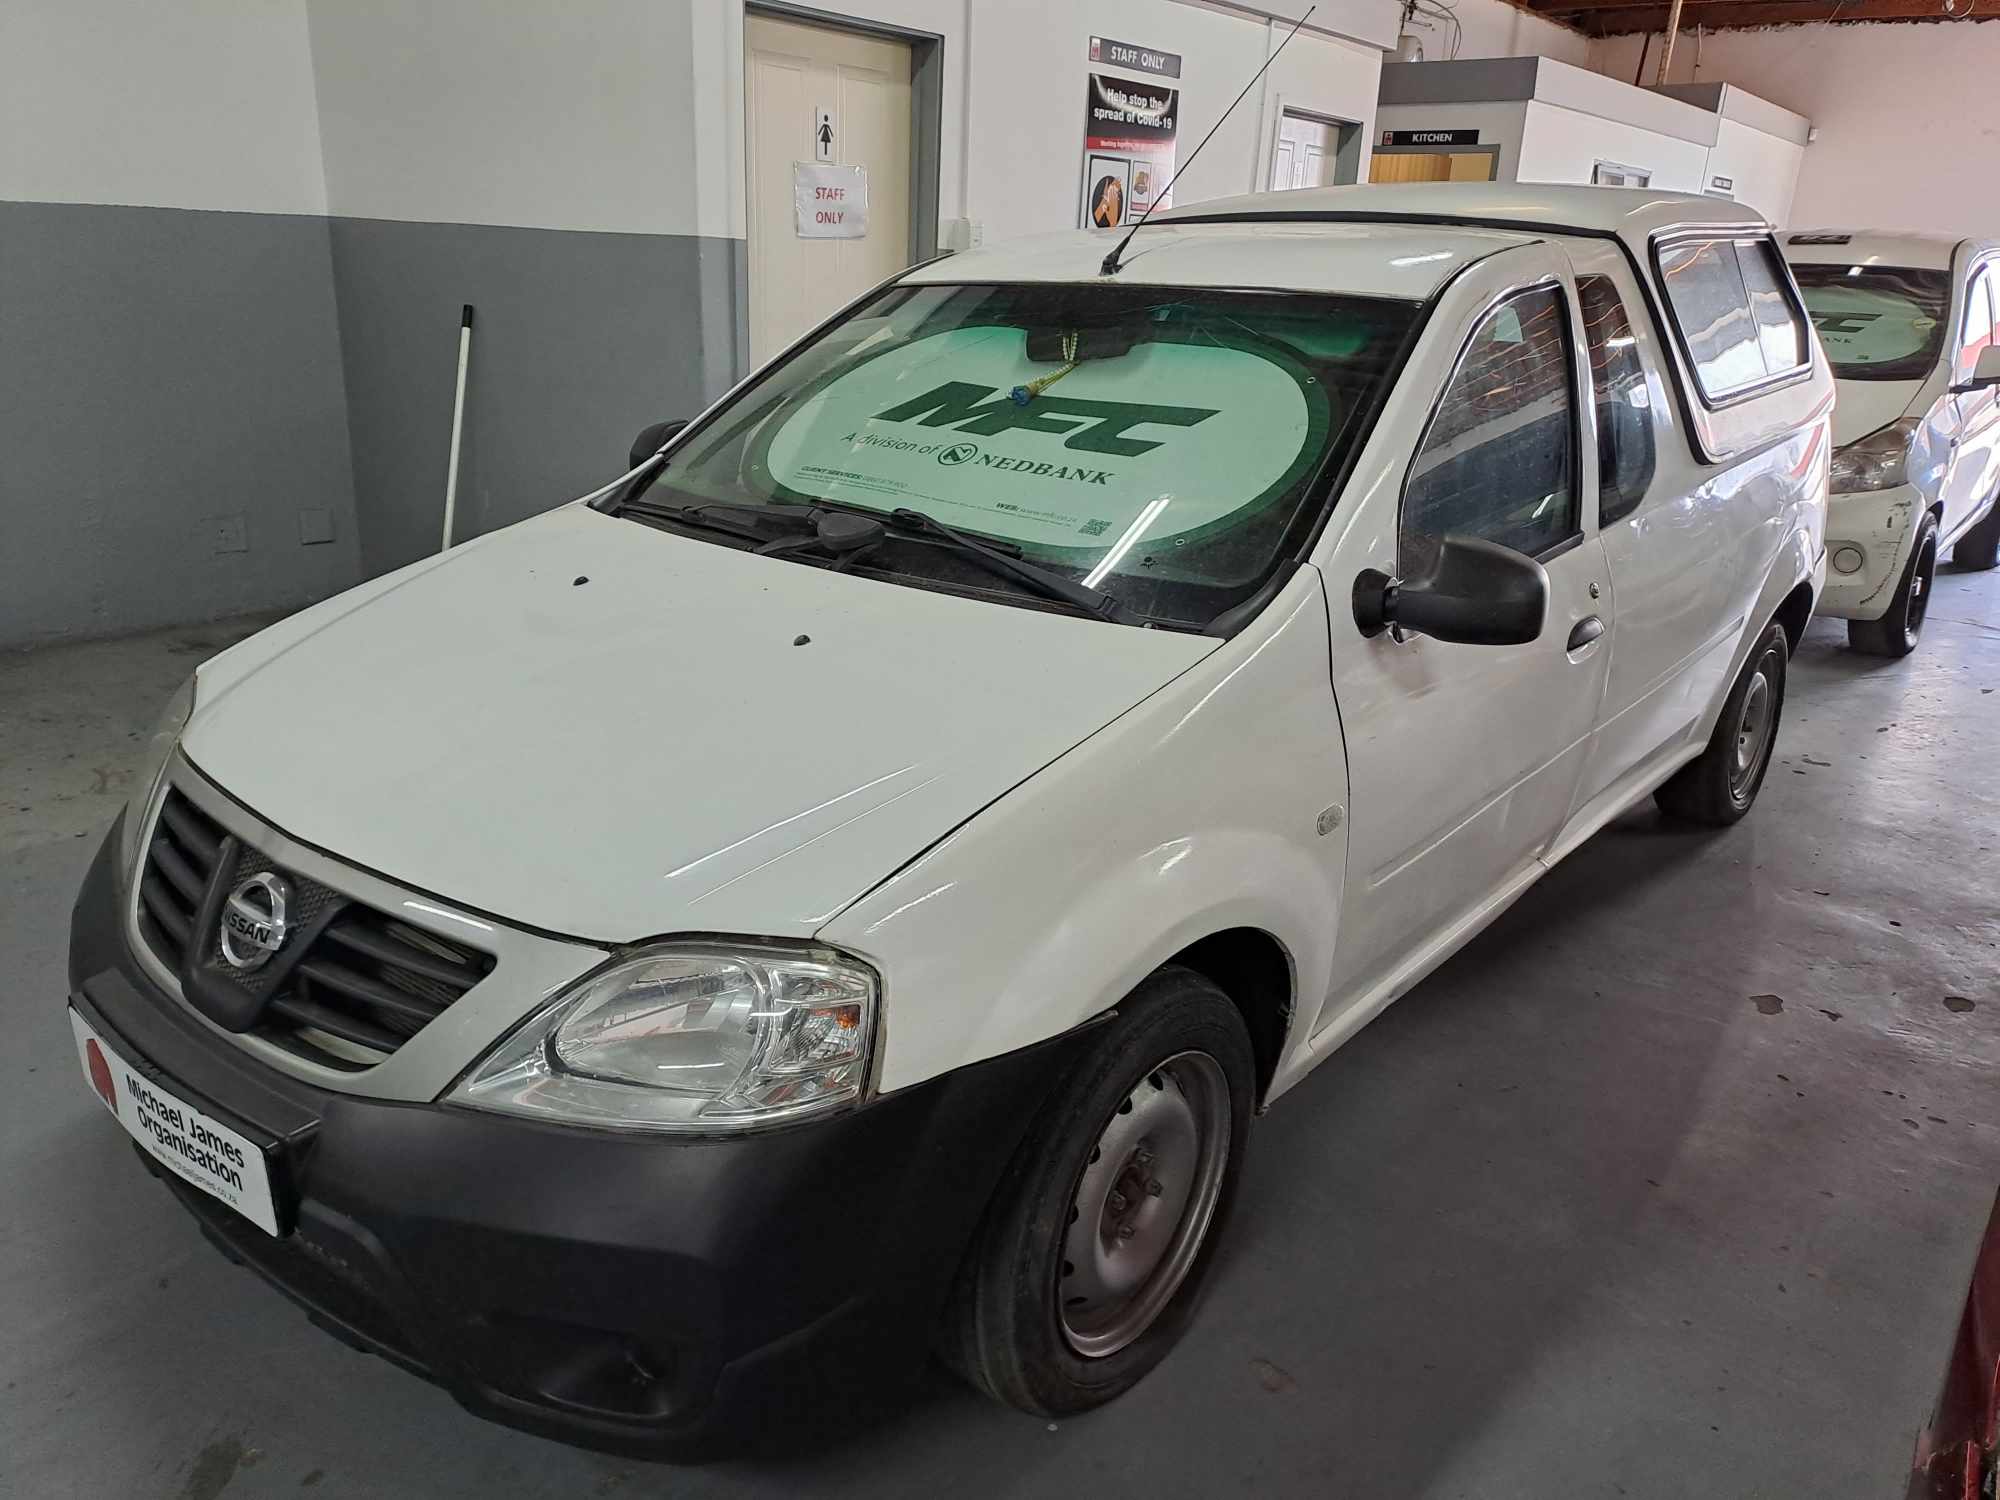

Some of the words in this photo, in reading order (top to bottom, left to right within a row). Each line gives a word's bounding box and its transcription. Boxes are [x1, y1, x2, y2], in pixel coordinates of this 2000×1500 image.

[1111, 46, 1138, 64] STAFF
[1140, 53, 1166, 70] ONLY
[1107, 88, 1128, 105] Help
[1129, 94, 1148, 109] stop
[1149, 96, 1163, 110] the
[1094, 107, 1124, 121] spread
[1126, 113, 1136, 123] of
[1136, 114, 1172, 129] Covid-19
[1412, 133, 1453, 143] KITCHEN
[815, 186, 845, 201] STAFF
[815, 211, 844, 225] ONLY
[870, 381, 1223, 458] MFC
[841, 432, 856, 443] A
[857, 433, 916, 453] division
[917, 444, 941, 456] of
[973, 453, 1115, 486] NEDBANK
[126, 1073, 185, 1132] Michael
[189, 1117, 245, 1168] James
[137, 1105, 243, 1192] Organisation
